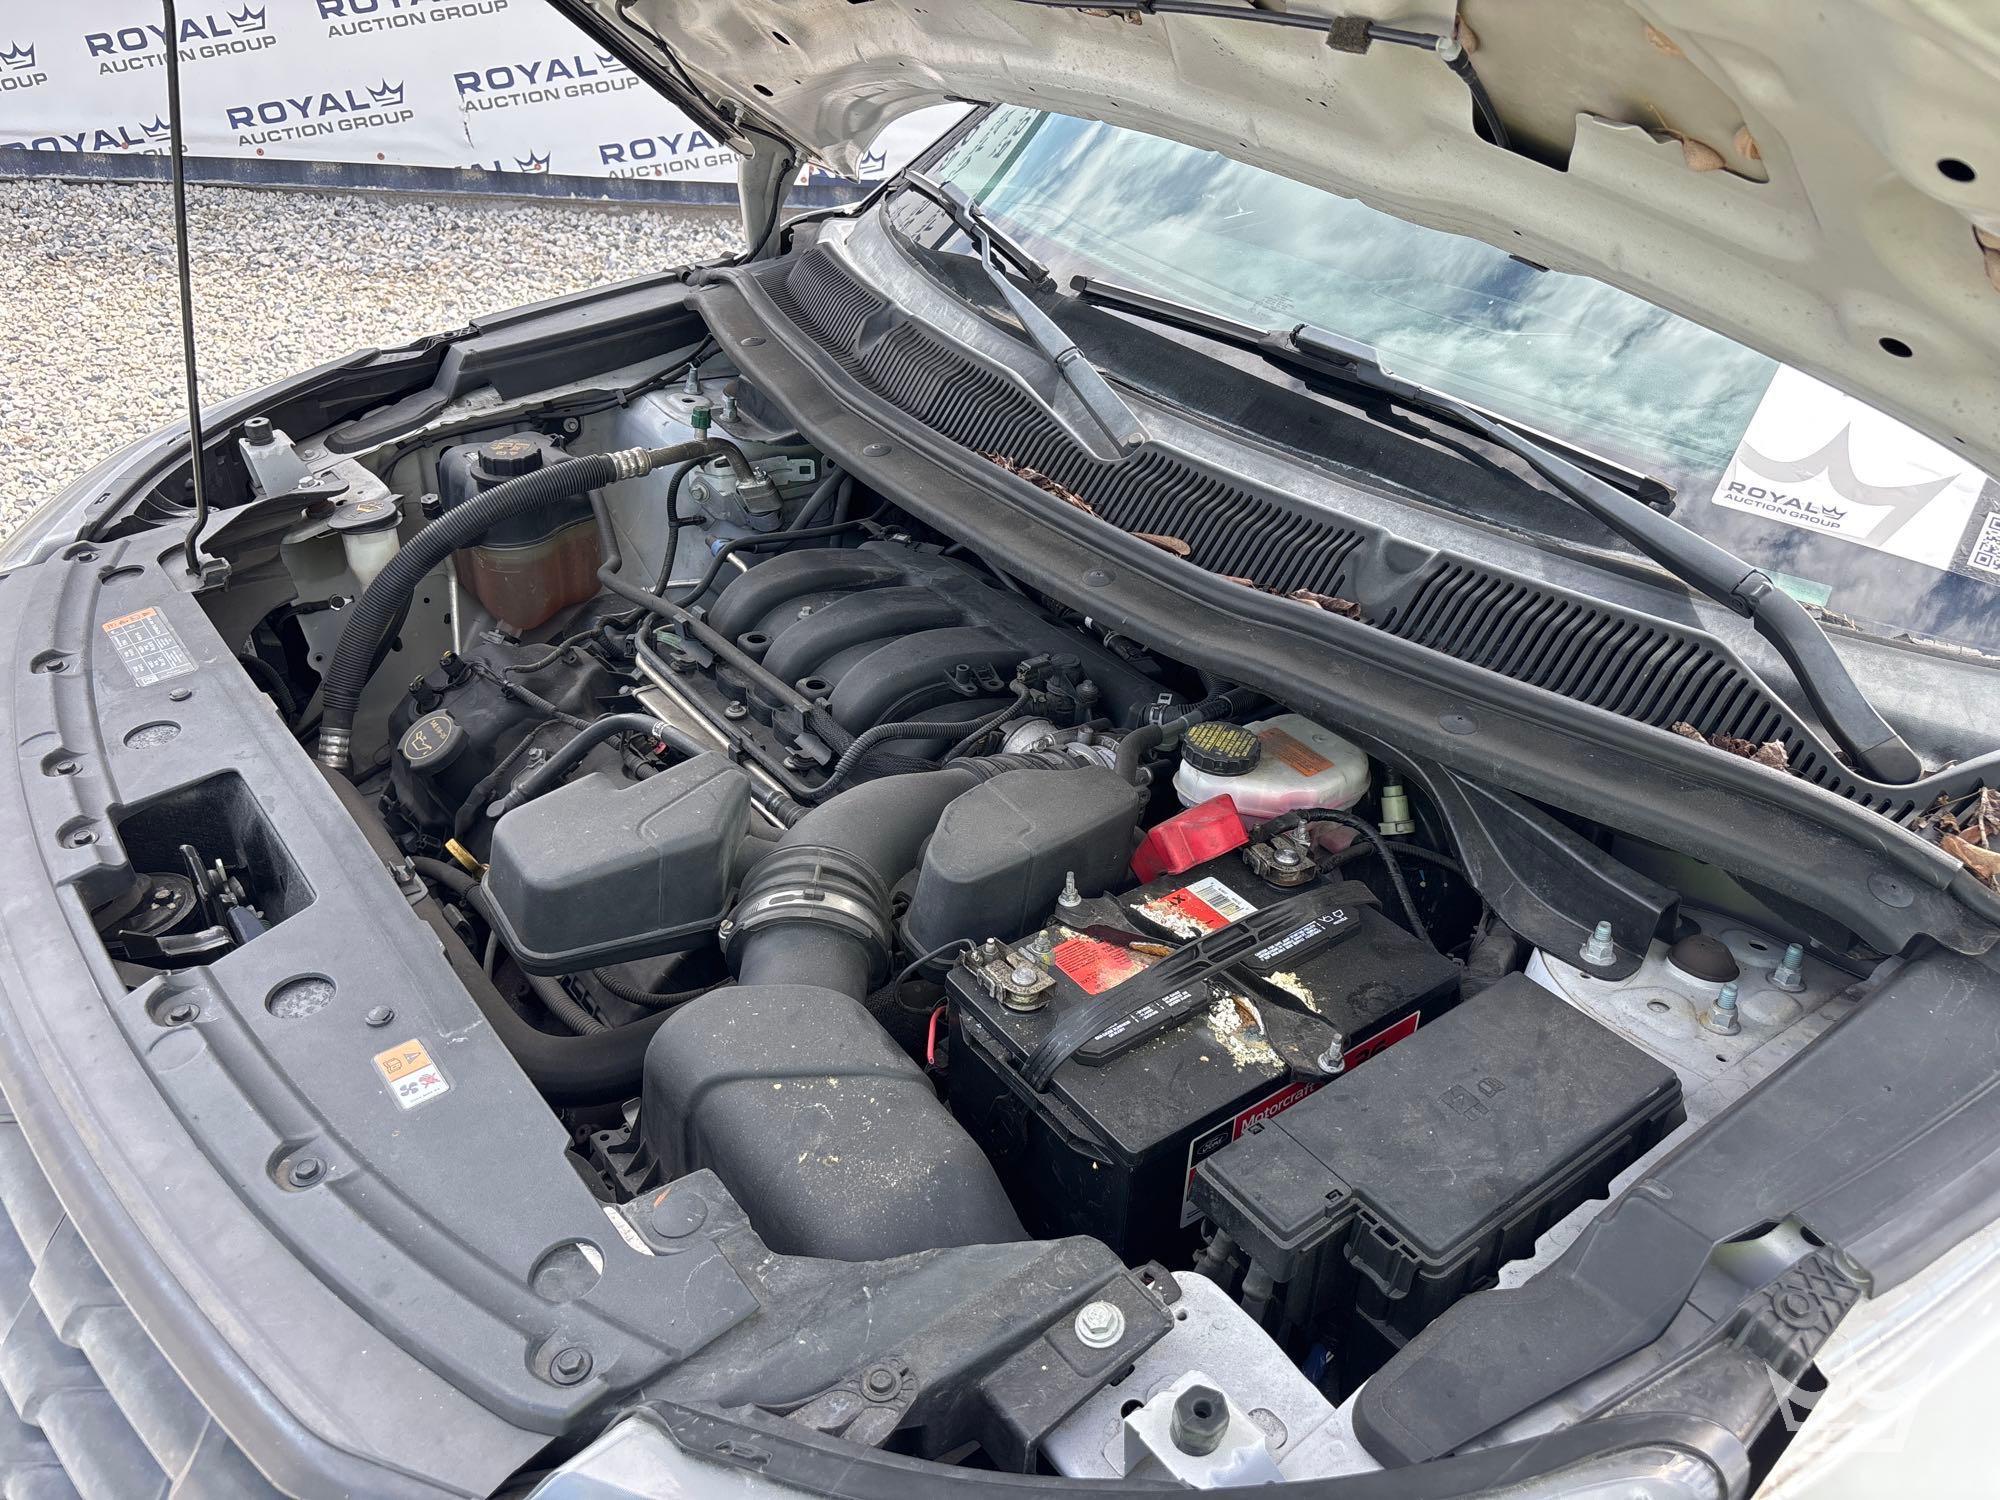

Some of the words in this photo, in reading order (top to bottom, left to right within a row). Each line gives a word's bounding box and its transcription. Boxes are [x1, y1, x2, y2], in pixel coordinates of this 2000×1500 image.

[328, 11, 426, 38] AUCTION
[430, 0, 509, 23] GROUP
[99, 47, 197, 75] AUCTIN
[200, 35, 277, 59] GROUP
[0, 72, 48, 91] OUP
[453, 55, 599, 95] ROYAL
[225, 89, 371, 130] ROYAL
[465, 87, 560, 113] AUCTION
[564, 76, 640, 97] GROUP
[239, 121, 334, 147] AUCTION
[338, 109, 415, 131] GROUP
[598, 130, 726, 166] ROYA
[608, 158, 700, 180] AUCTION
[1724, 493, 1787, 515] AUCTION
[1789, 510, 1841, 529] GROUP
[1727, 480, 1819, 514] ROYAL
[1241, 1082, 1315, 1134] Motorcraft
